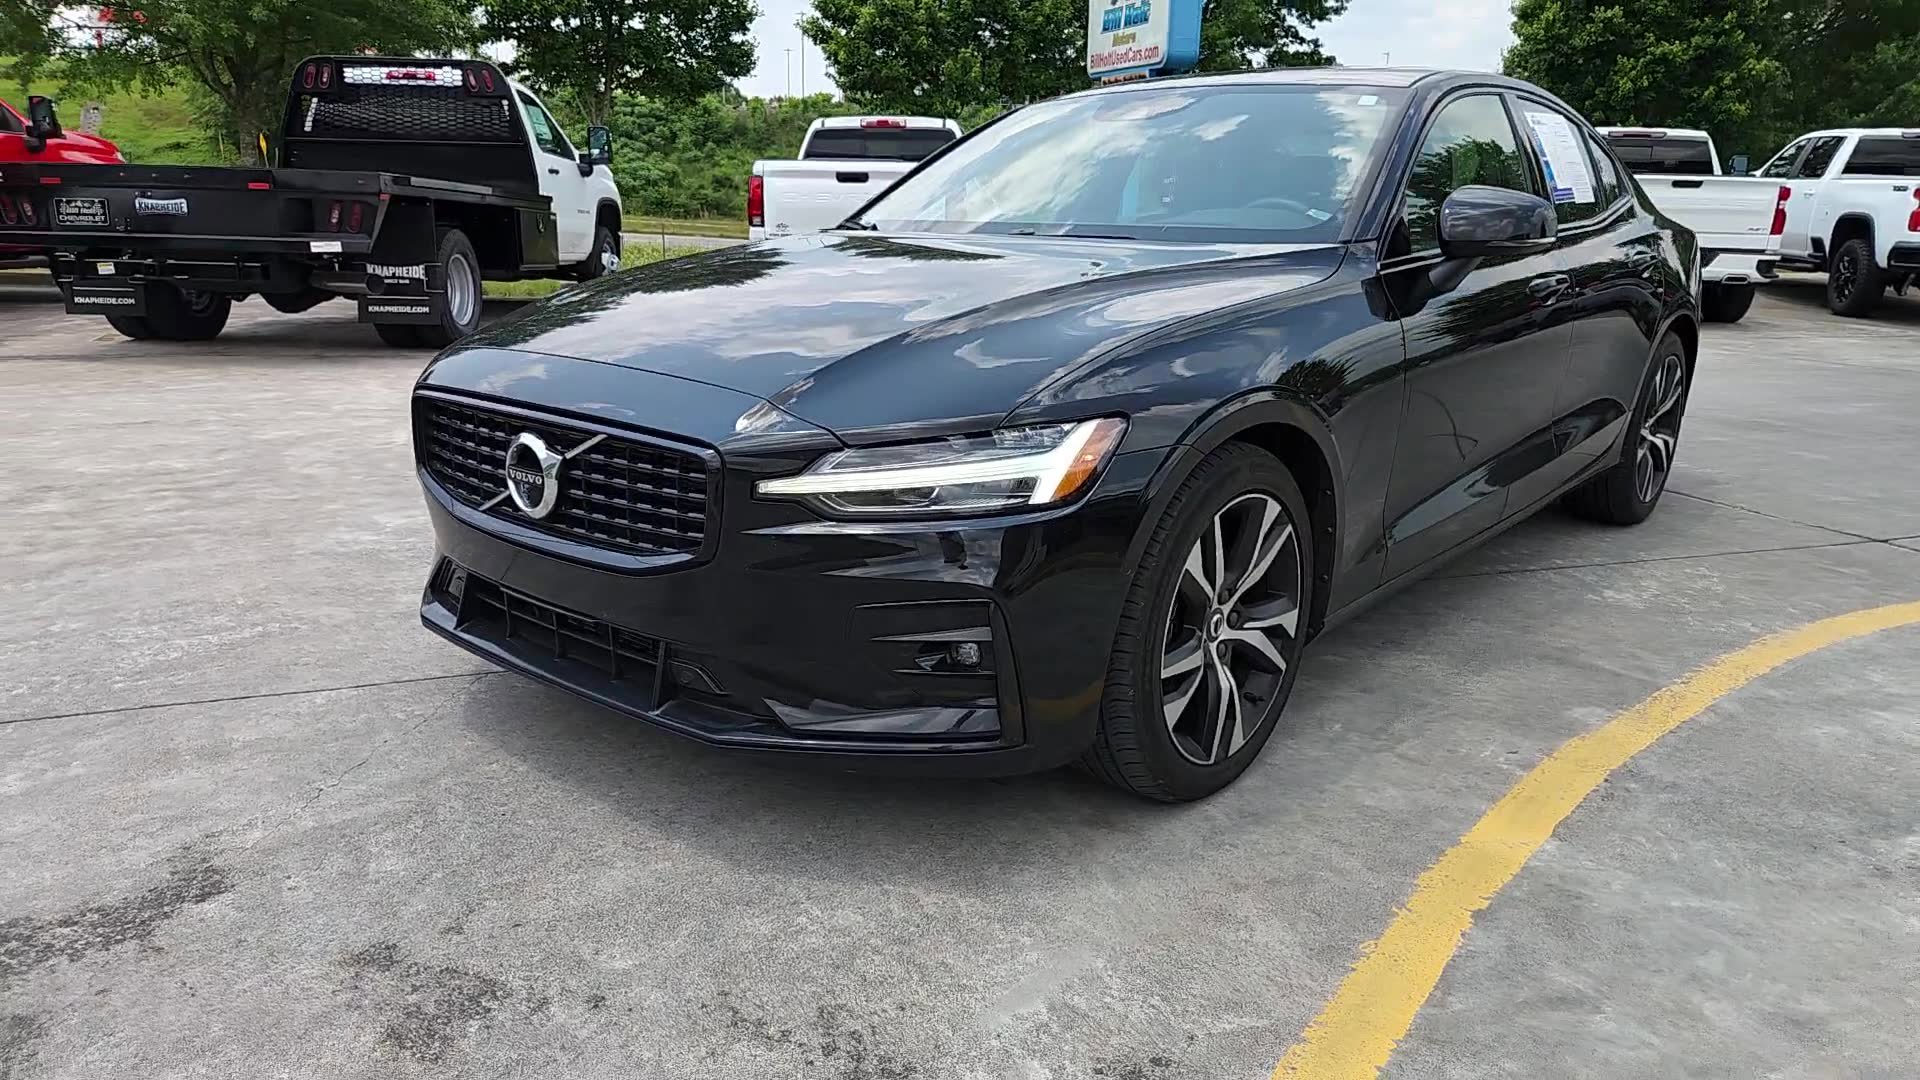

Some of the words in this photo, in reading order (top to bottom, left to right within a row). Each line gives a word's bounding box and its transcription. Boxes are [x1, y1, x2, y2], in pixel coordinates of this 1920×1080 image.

[1090, 46, 1159, 69] BillHoltUsedCars.com
[138, 201, 186, 213] KNAPHEIDE
[366, 263, 425, 279] KNAPHEIDE
[73, 296, 136, 304] KNAPHEIDE.COM
[368, 305, 429, 313] KNAPHEIDE.COM
[509, 469, 543, 485] VOLVO
